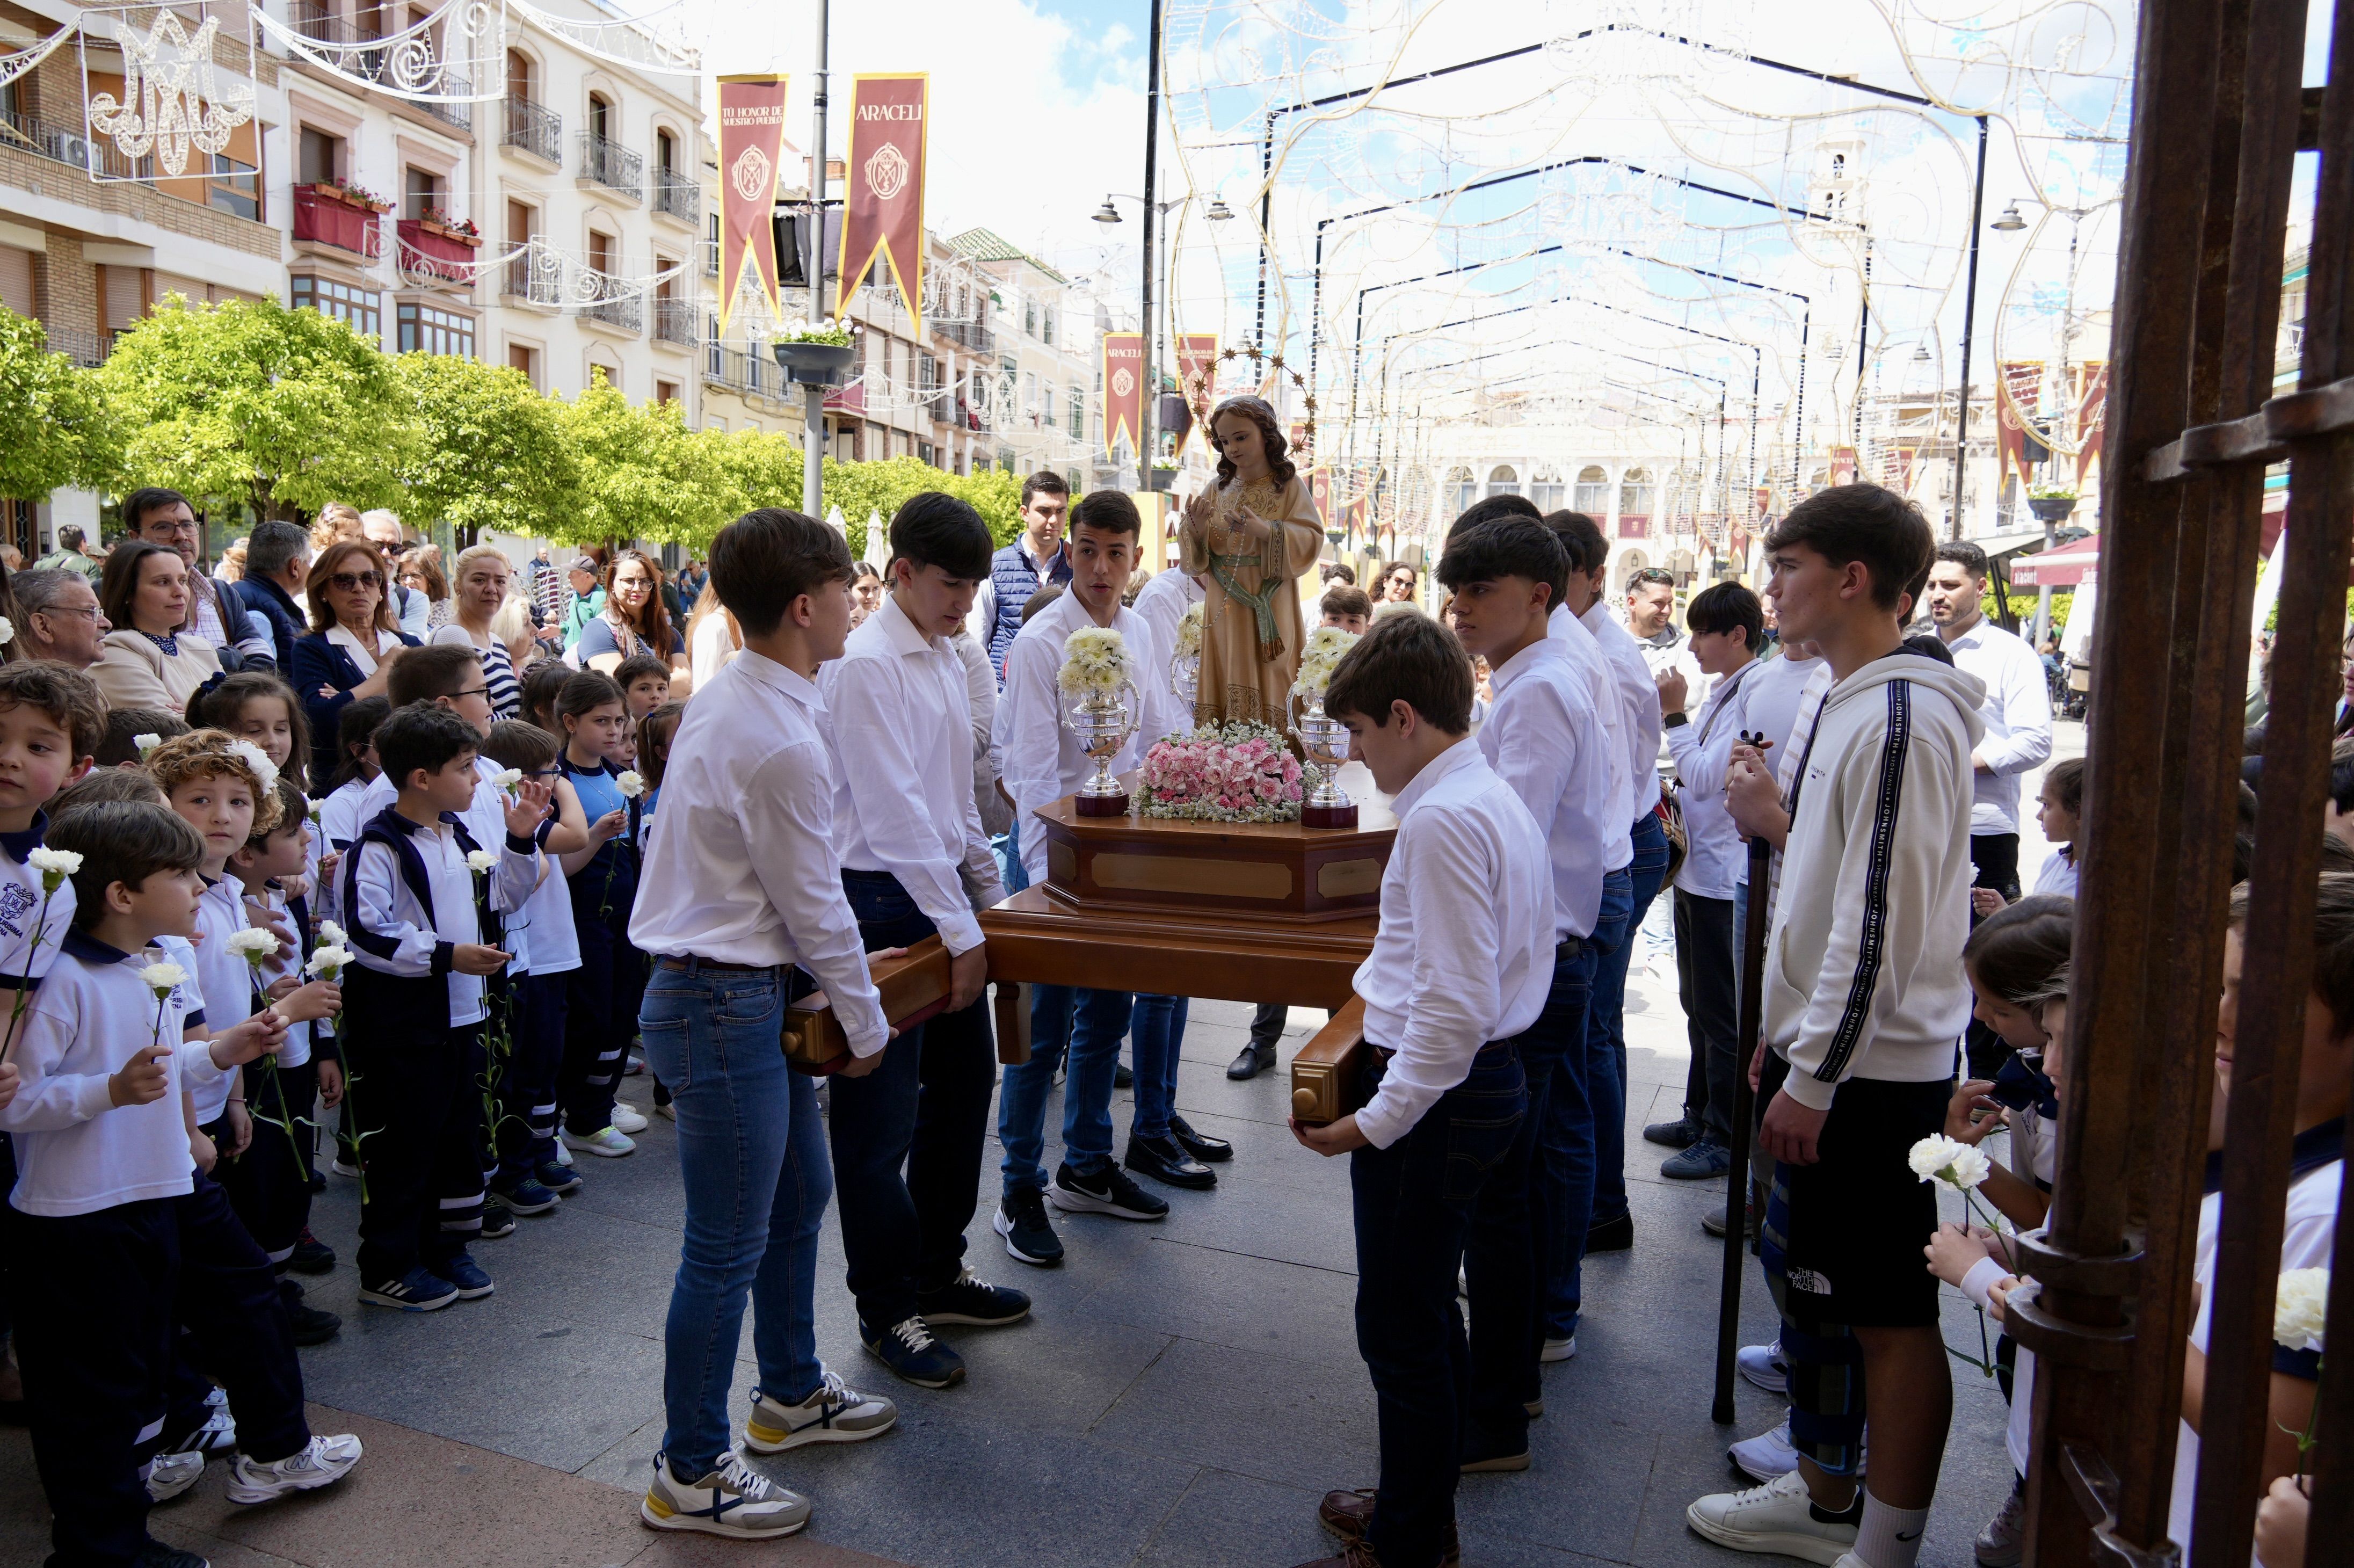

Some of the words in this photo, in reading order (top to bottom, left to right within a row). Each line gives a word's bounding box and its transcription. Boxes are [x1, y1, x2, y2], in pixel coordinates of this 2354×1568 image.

[722, 107, 735, 118] TÚ
[737, 106, 769, 118] HONOR
[772, 106, 783, 116] DE
[856, 104, 922, 121] ARACELI
[723, 117, 755, 126] NUESTRO
[756, 116, 782, 125] PUEBLO
[1107, 349, 1142, 358] ARACELI
[1892, 703, 1902, 748] JOHNSMITH
[1885, 756, 1895, 795] SPORTSWEAR
[1877, 803, 1891, 856] JOHNSMITH
[1786, 1268, 1813, 1285] NORTH
[1796, 1267, 1813, 1277] THE
[1792, 1279, 1813, 1291] FACE
